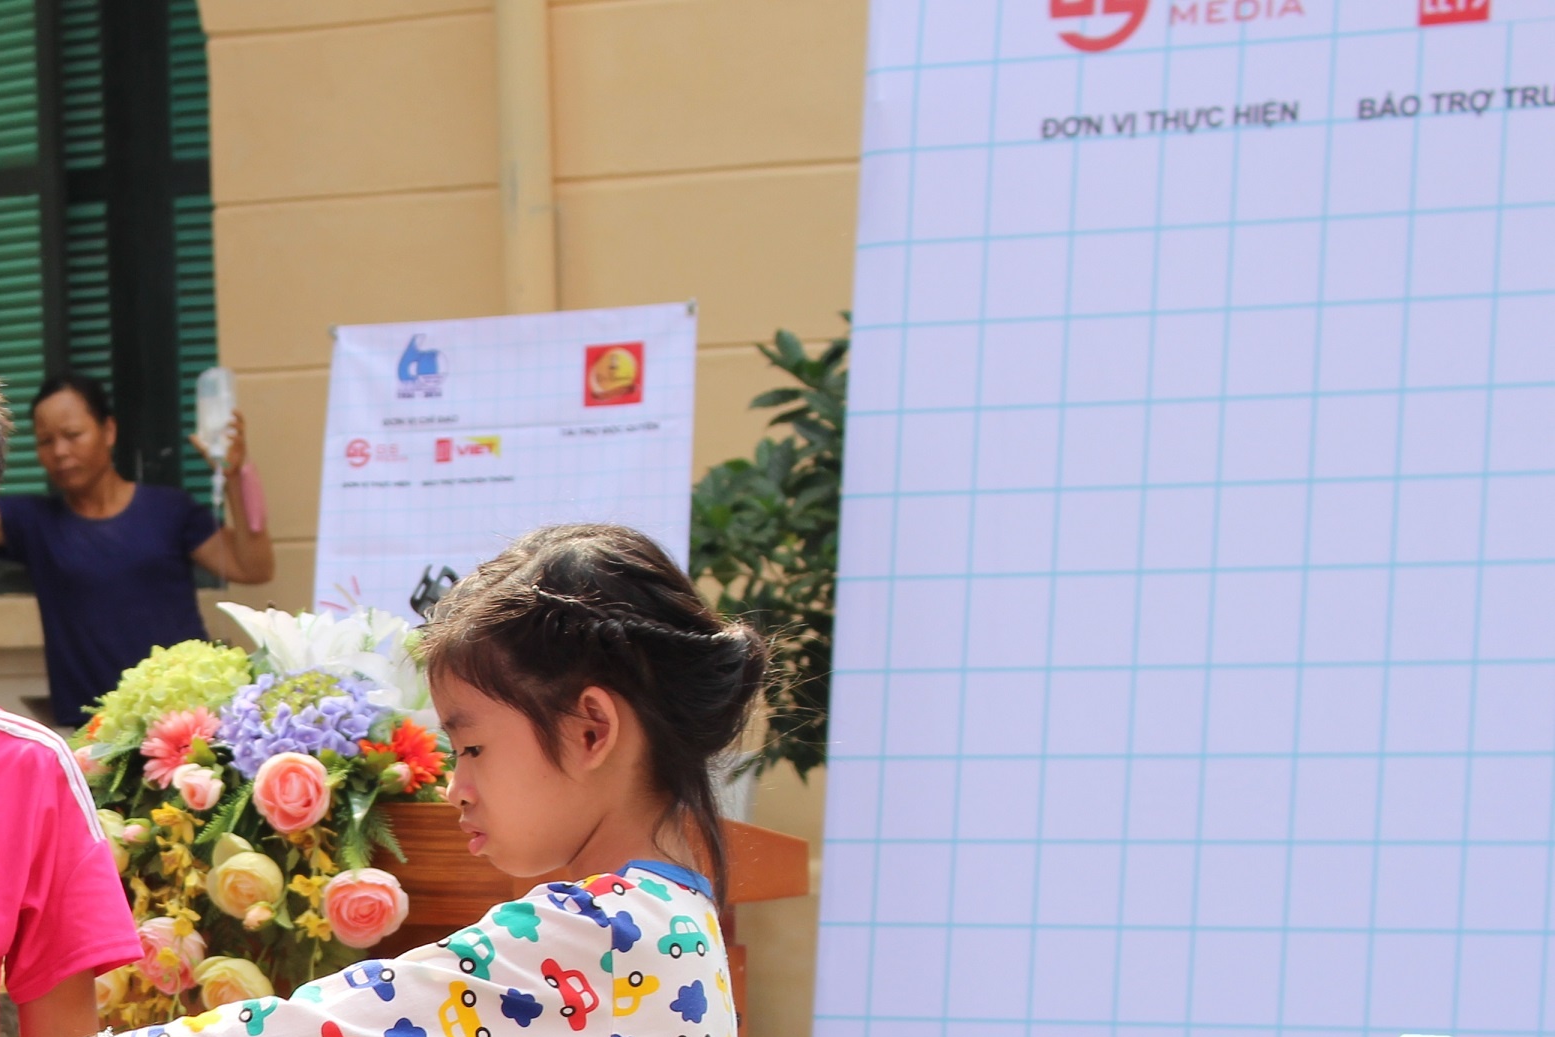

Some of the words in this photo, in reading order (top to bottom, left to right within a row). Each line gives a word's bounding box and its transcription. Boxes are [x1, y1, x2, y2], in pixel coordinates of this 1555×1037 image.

[1041, 114, 1104, 139] ĐƠN
[1111, 112, 1136, 137] VỊ
[1146, 106, 1224, 133] THỰC
[1233, 100, 1299, 128] HIỆN
[1431, 89, 1495, 118] TRỢ
